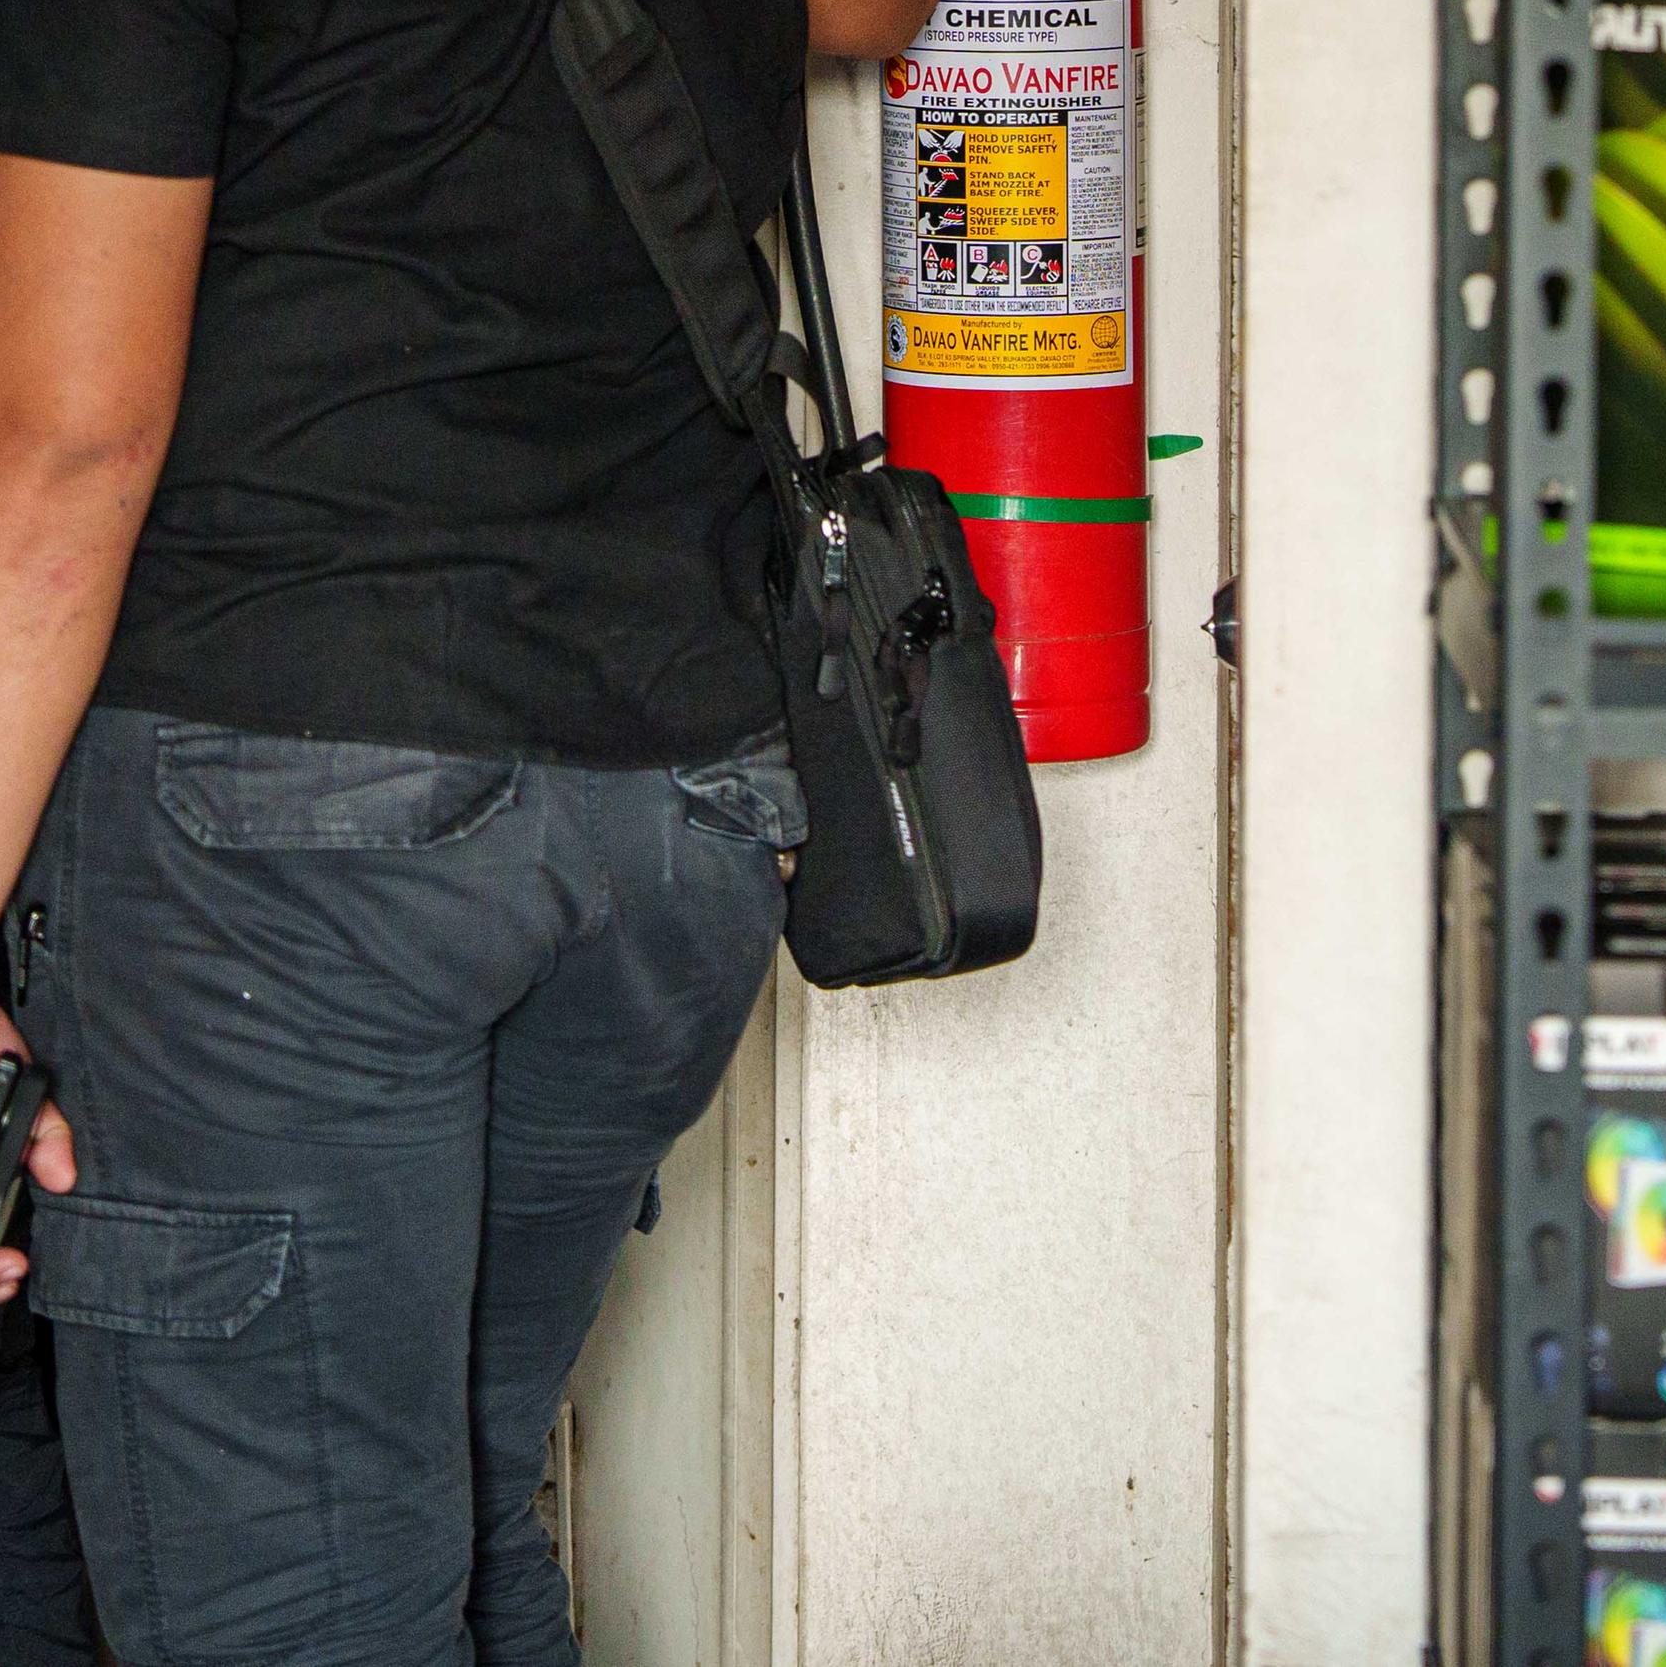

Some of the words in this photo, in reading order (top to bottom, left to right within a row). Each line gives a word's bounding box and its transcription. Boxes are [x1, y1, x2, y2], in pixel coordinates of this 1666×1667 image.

[946, 8, 1097, 28] CHEMICAL
[925, 32, 964, 42] (STORED
[968, 31, 1024, 42] PRESSURE
[1029, 31, 1057, 44] TYPE)
[907, 60, 993, 94] DAVAO
[1002, 63, 1119, 94] VANFIRE
[922, 96, 957, 107] FIRE
[964, 96, 1101, 109] EXTINGUISHER
[923, 112, 954, 122] HOW
[958, 112, 975, 123] TO
[984, 113, 1059, 124] OPERATE
[1075, 114, 1117, 122] MAINTENANCE
[969, 134, 998, 142] HOLD
[1002, 134, 1055, 144] UPRIGHT,
[969, 145, 1017, 154] REMOVE
[1018, 145, 1057, 154] SAFETY
[969, 156, 991, 164] PIN.
[1085, 166, 1111, 174] CAUTION
[970, 207, 1019, 216] SQUEEZE
[1023, 207, 1059, 217] LEVER,
[970, 217, 1007, 225] SWEEP
[1011, 217, 1037, 225] SIDE
[1041, 217, 1055, 225] TO
[969, 227, 998, 235] SIDE.
[1082, 242, 1115, 250] IMPORTANT
[927, 248, 936, 259] A
[974, 249, 983, 260] B
[1027, 249, 1038, 260] C
[947, 299, 953, 309] TO
[955, 300, 963, 310] USE
[965, 300, 981, 311] OTHER
[982, 300, 995, 311] THAN
[997, 301, 1005, 311] THE
[1007, 300, 1045, 312] RECOMMENDED
[961, 319, 1009, 328] Manufactured
[913, 327, 956, 349] DAVAO
[961, 330, 1028, 351] VANFIRE
[1034, 331, 1081, 351] MKTG.
